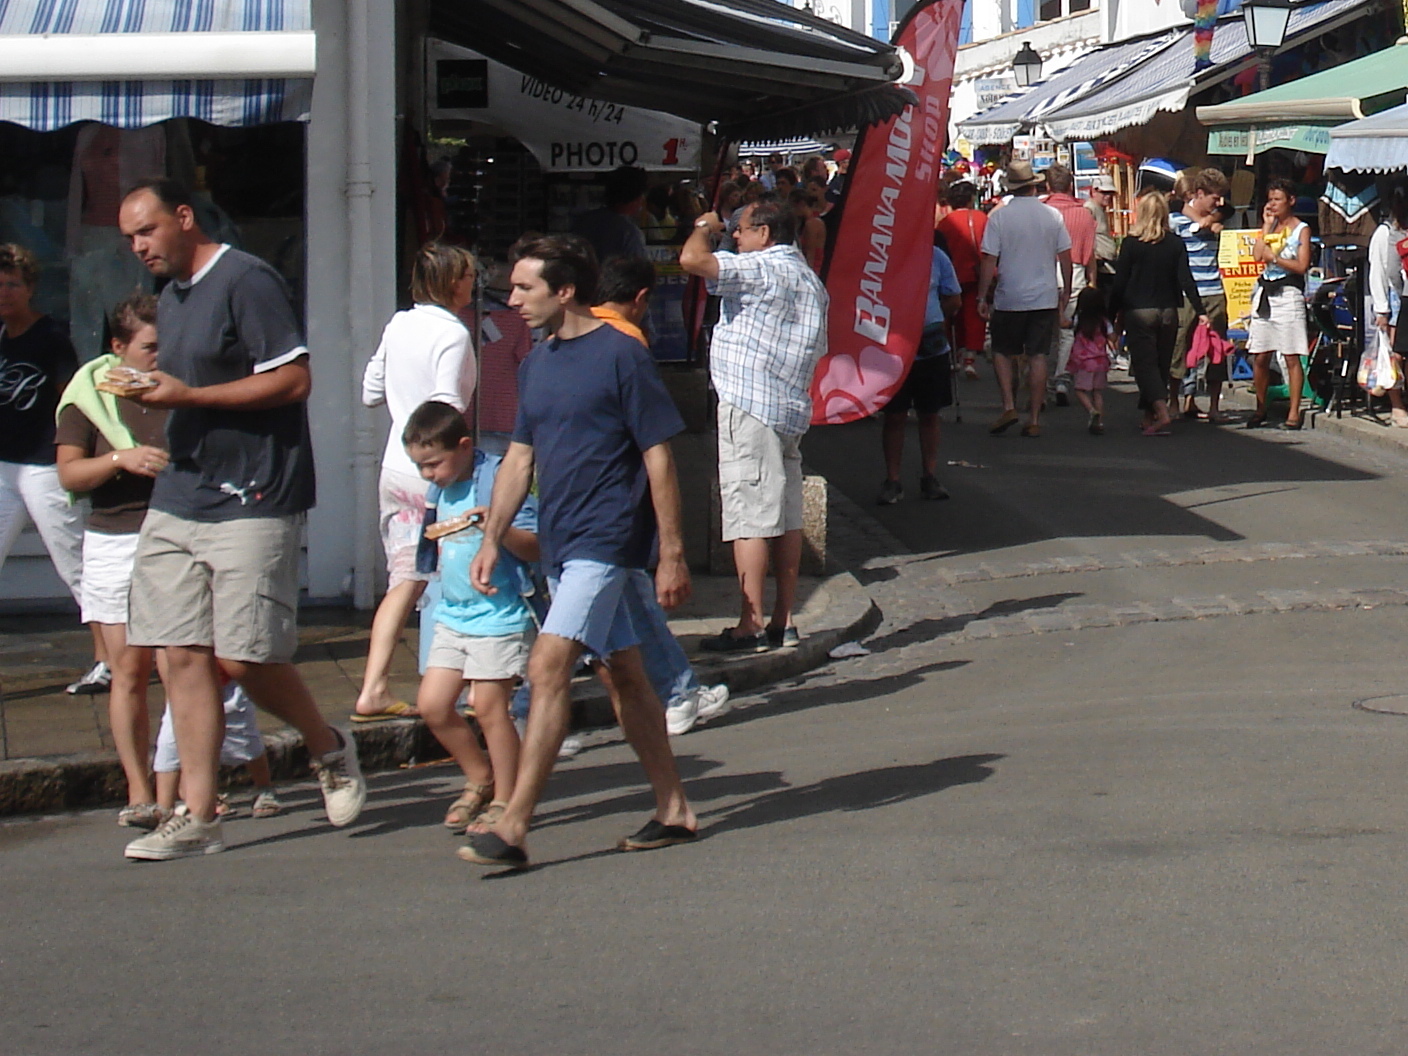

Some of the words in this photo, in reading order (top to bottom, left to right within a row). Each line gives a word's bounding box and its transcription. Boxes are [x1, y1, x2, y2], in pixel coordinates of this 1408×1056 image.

[566, 95, 585, 112] 24
[915, 95, 941, 182] SHOP
[551, 142, 638, 167] PHOTO
[1224, 263, 1267, 276] ENTRE
